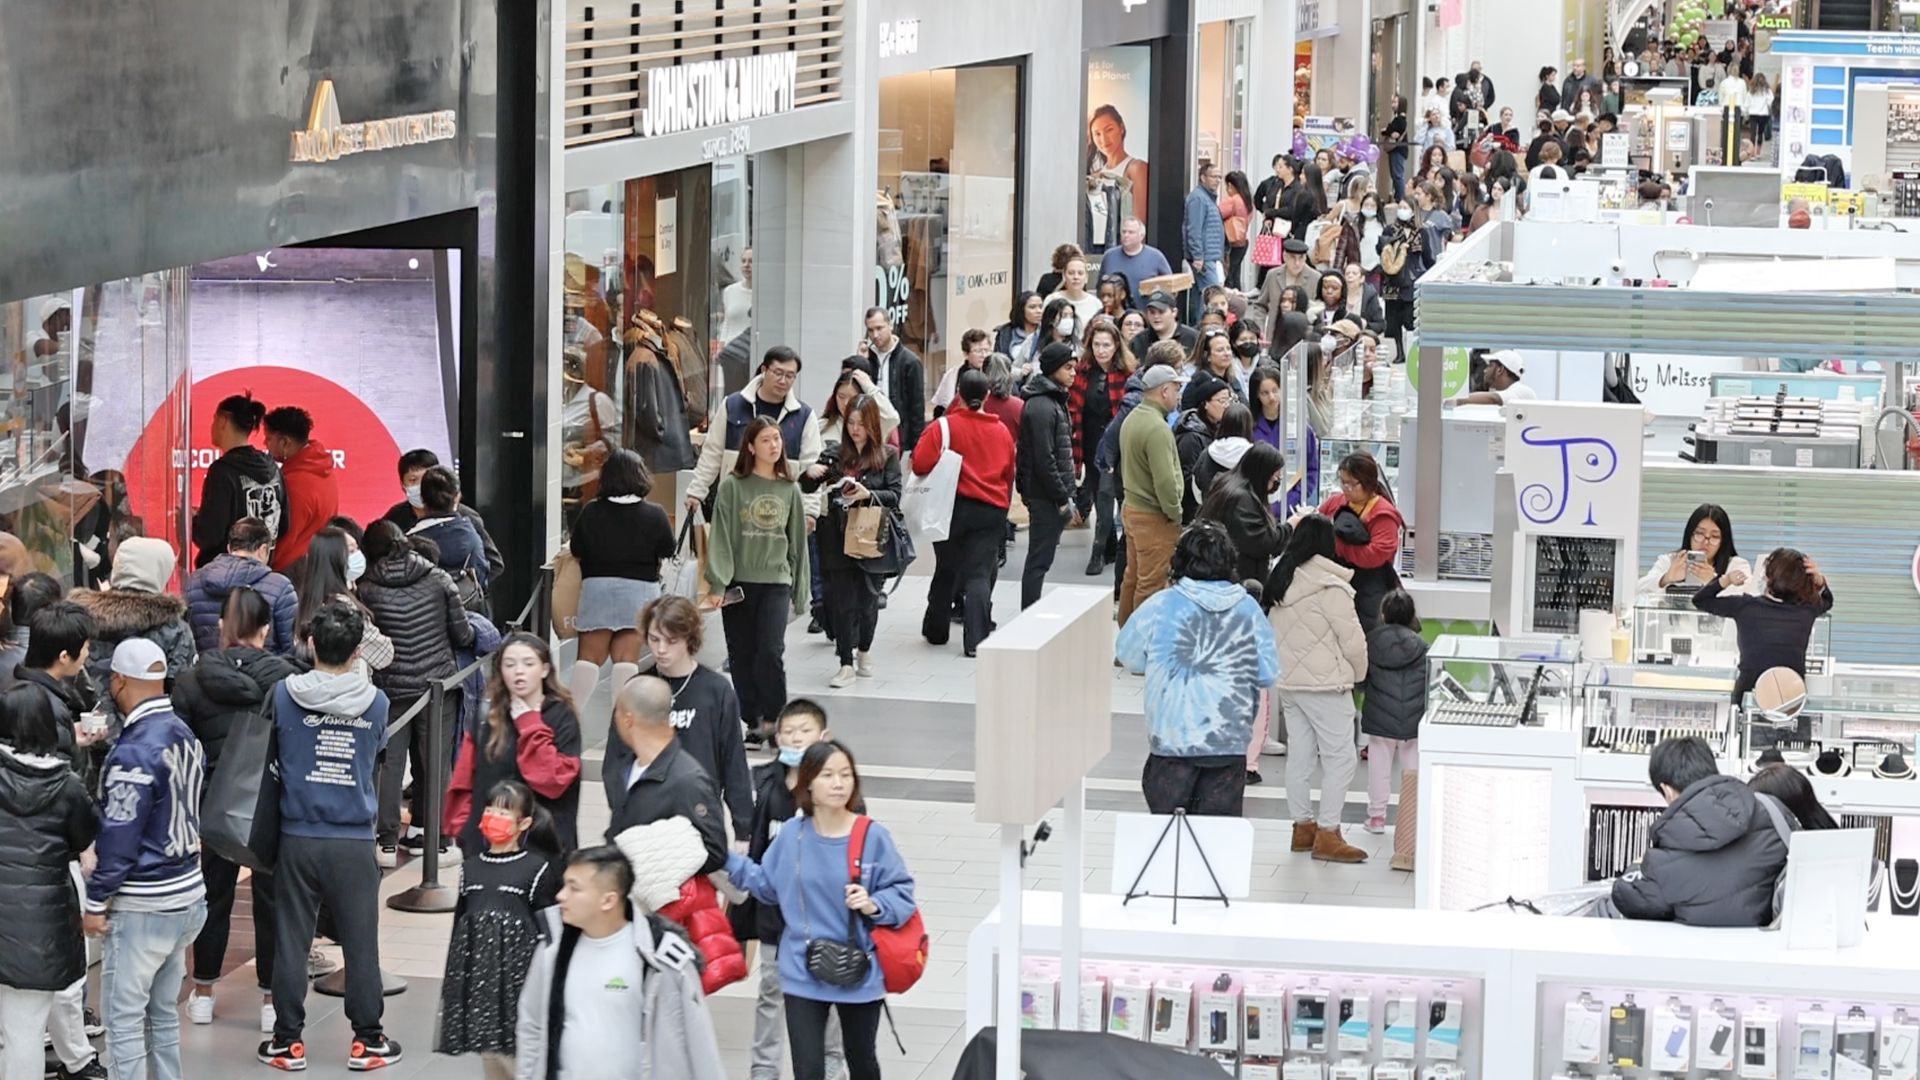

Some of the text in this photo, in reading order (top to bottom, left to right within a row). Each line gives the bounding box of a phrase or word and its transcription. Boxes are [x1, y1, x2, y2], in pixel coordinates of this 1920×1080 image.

[1757, 14, 1791, 28] Jam
[1866, 44, 1893, 54] Teeth
[1103, 71, 1130, 80] Planet
[290, 110, 456, 162] MOOSE KNUCKLES
[968, 274, 984, 289] OAK
[990, 271, 1008, 286] FORT
[1634, 366, 1648, 393] by
[669, 708, 696, 728] BEY
